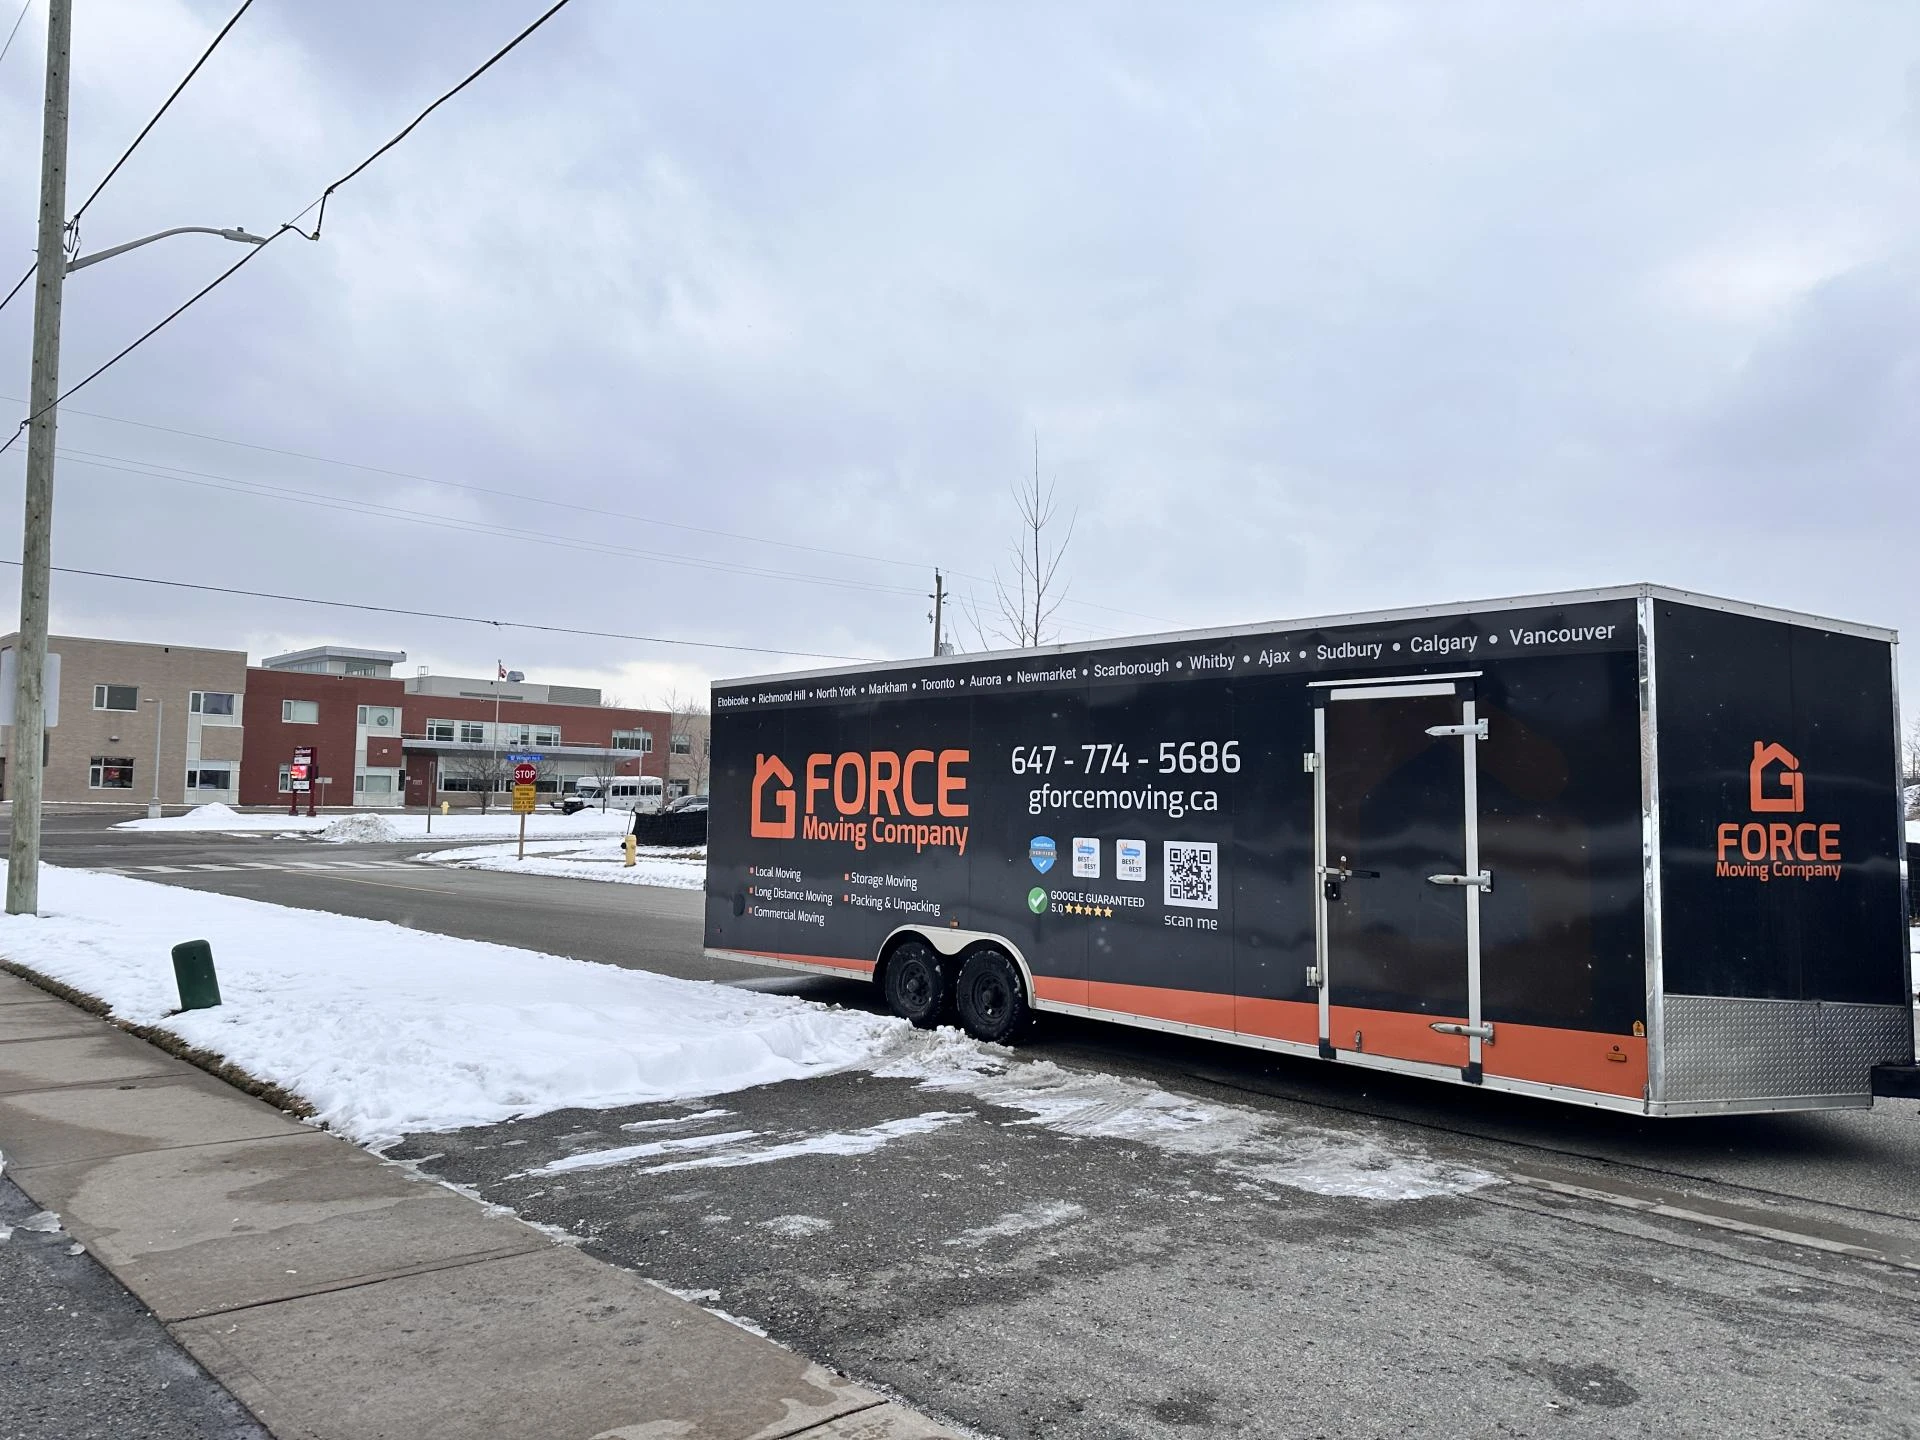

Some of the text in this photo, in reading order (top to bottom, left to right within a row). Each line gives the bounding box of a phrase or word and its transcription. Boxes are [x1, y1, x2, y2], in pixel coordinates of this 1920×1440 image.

[718, 622, 1616, 707] Etobicoke Richmond Hill North York Markham Toronto Aurora Newmarket Scarborough Whitby Ajax Sudbury Calgary Vancouver
[1011, 745, 1057, 774] 647
[1081, 743, 1130, 774] 774
[1158, 740, 1241, 774] 5686
[515, 770, 536, 779] STOP
[806, 749, 970, 817] FORCE
[1028, 782, 1218, 818] gforcemoving.ca
[802, 815, 969, 856] Moving Company
[1717, 822, 1842, 861] FORCE
[755, 866, 802, 882] Local Moving
[851, 872, 918, 891] Storage Moving
[1716, 861, 1842, 882] Moving Company
[754, 886, 833, 906] Long Distance Moving
[850, 894, 940, 916] Packing & Unpacking
[1050, 890, 1145, 908] GOOGLE GUARANTEED
[754, 906, 825, 926] Commercial Moving
[1050, 902, 1064, 914] 5.0
[1164, 914, 1218, 930] scan me
